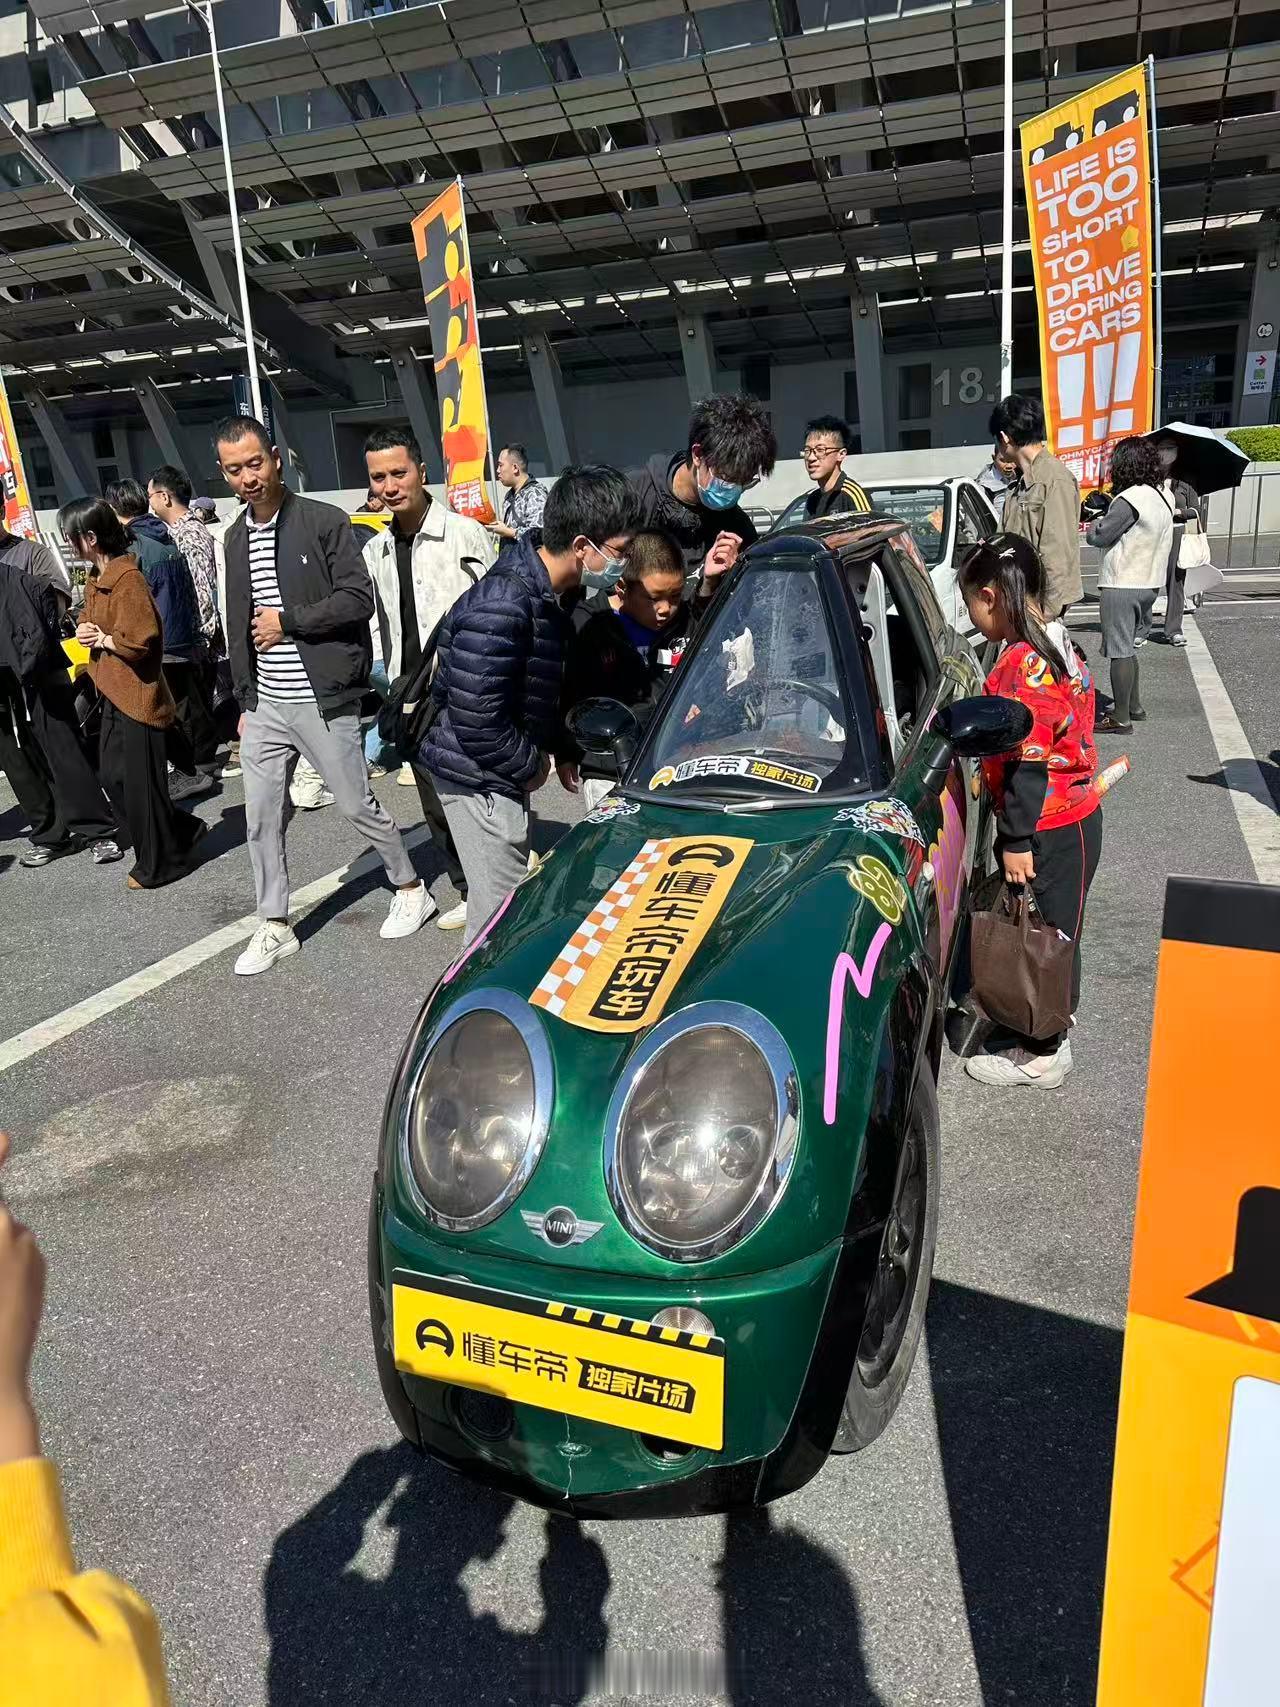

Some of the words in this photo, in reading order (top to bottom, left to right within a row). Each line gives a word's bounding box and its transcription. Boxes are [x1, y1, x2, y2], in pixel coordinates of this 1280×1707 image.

[1035, 152, 1100, 200] LIFE
[1107, 137, 1136, 167] IS
[1038, 165, 1138, 228] TOO
[1042, 198, 1139, 255] SHORT
[1044, 249, 1089, 280] TO
[1046, 252, 1142, 308] DRIVE
[1048, 281, 1142, 329] BORING
[1050, 302, 1141, 351] CARS
[677, 757, 740, 779] 懂车帝
[751, 761, 815, 789] 独家片场
[624, 870, 718, 955] 懂车帝
[599, 960, 663, 1016] 玩车
[546, 1220, 573, 1235] MINI
[462, 1331, 568, 1383] 懂车帝
[586, 1363, 688, 1410] 独家片场
